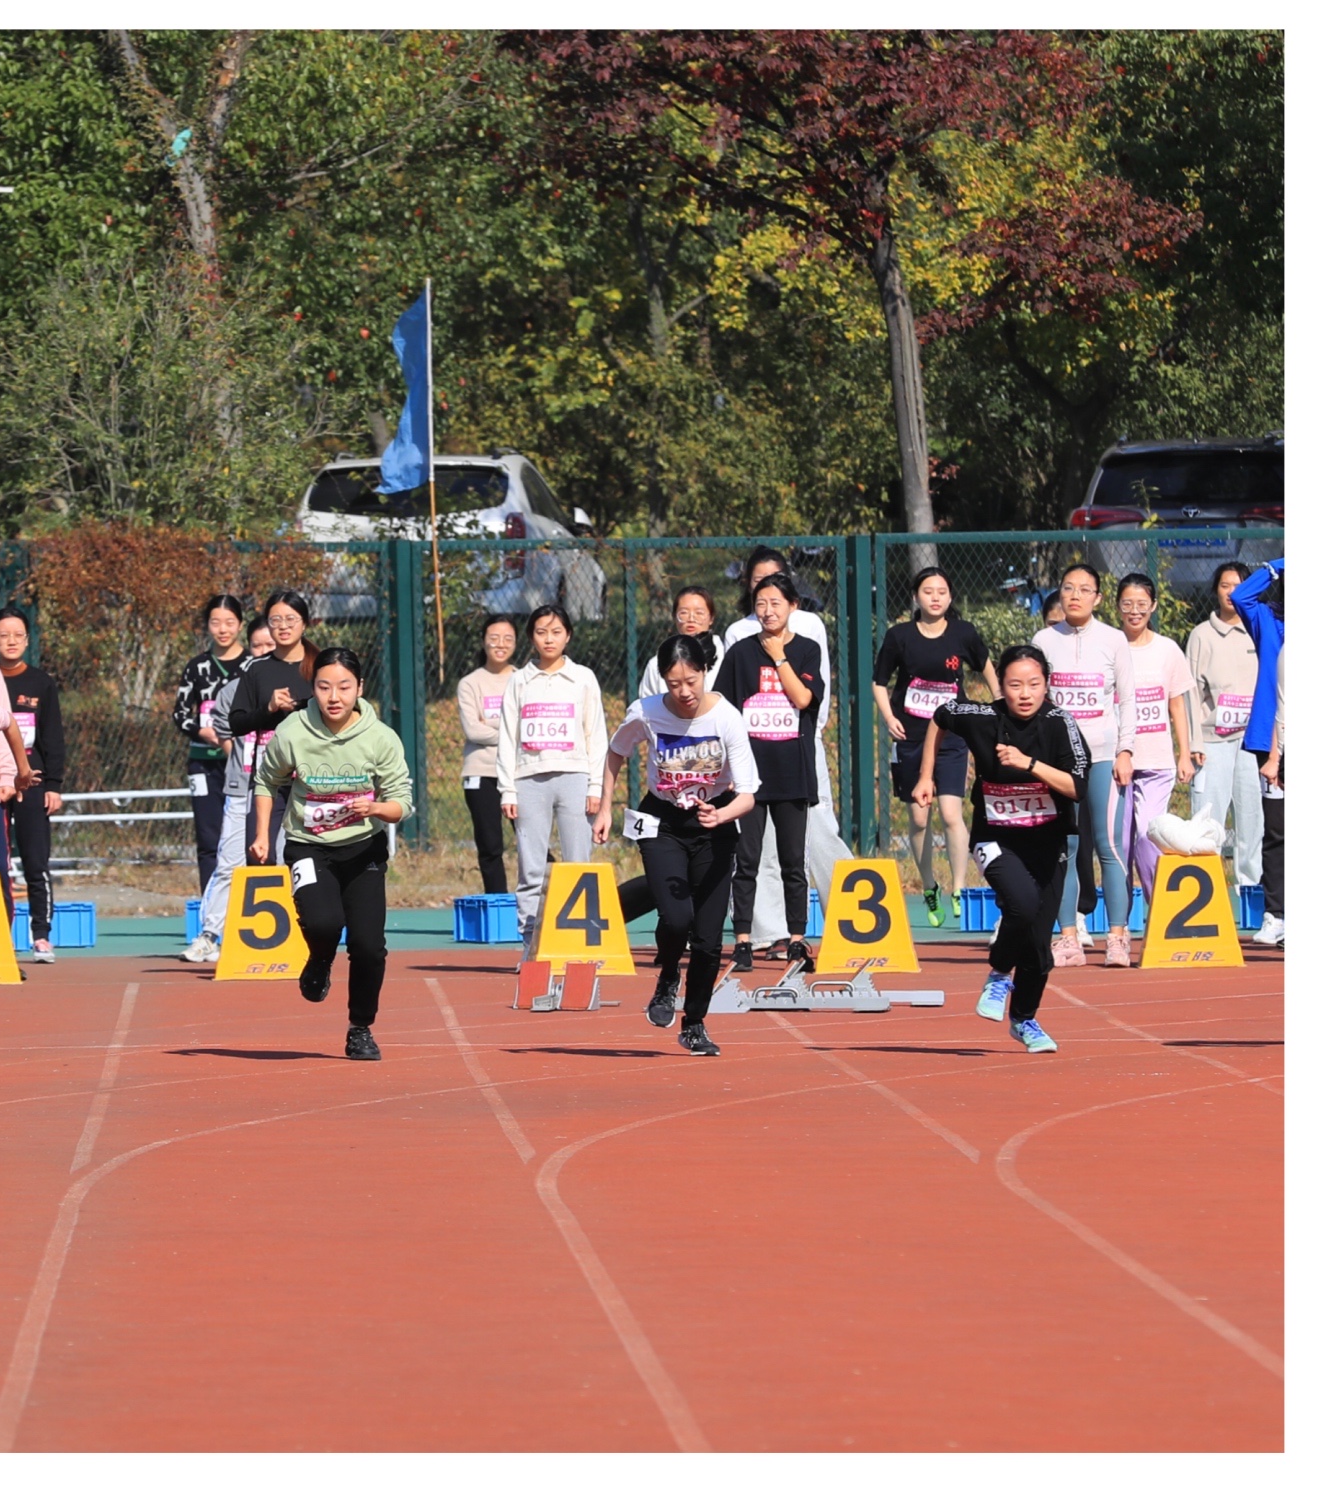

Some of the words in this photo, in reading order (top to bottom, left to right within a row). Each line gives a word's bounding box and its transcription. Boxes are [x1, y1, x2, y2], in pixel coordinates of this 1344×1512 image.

[1055, 691, 1098, 706] 0256
[749, 712, 794, 727] 0366
[1222, 710, 1250, 724] 017
[526, 722, 568, 737] 0164
[346, 776, 366, 784] School
[993, 796, 1048, 815] 0171
[633, 818, 644, 836] 4
[977, 846, 987, 865] 3
[292, 866, 301, 885] 5
[555, 872, 610, 947] 4
[837, 868, 892, 944] 3
[1164, 864, 1219, 940] 2
[237, 874, 291, 950] 5
